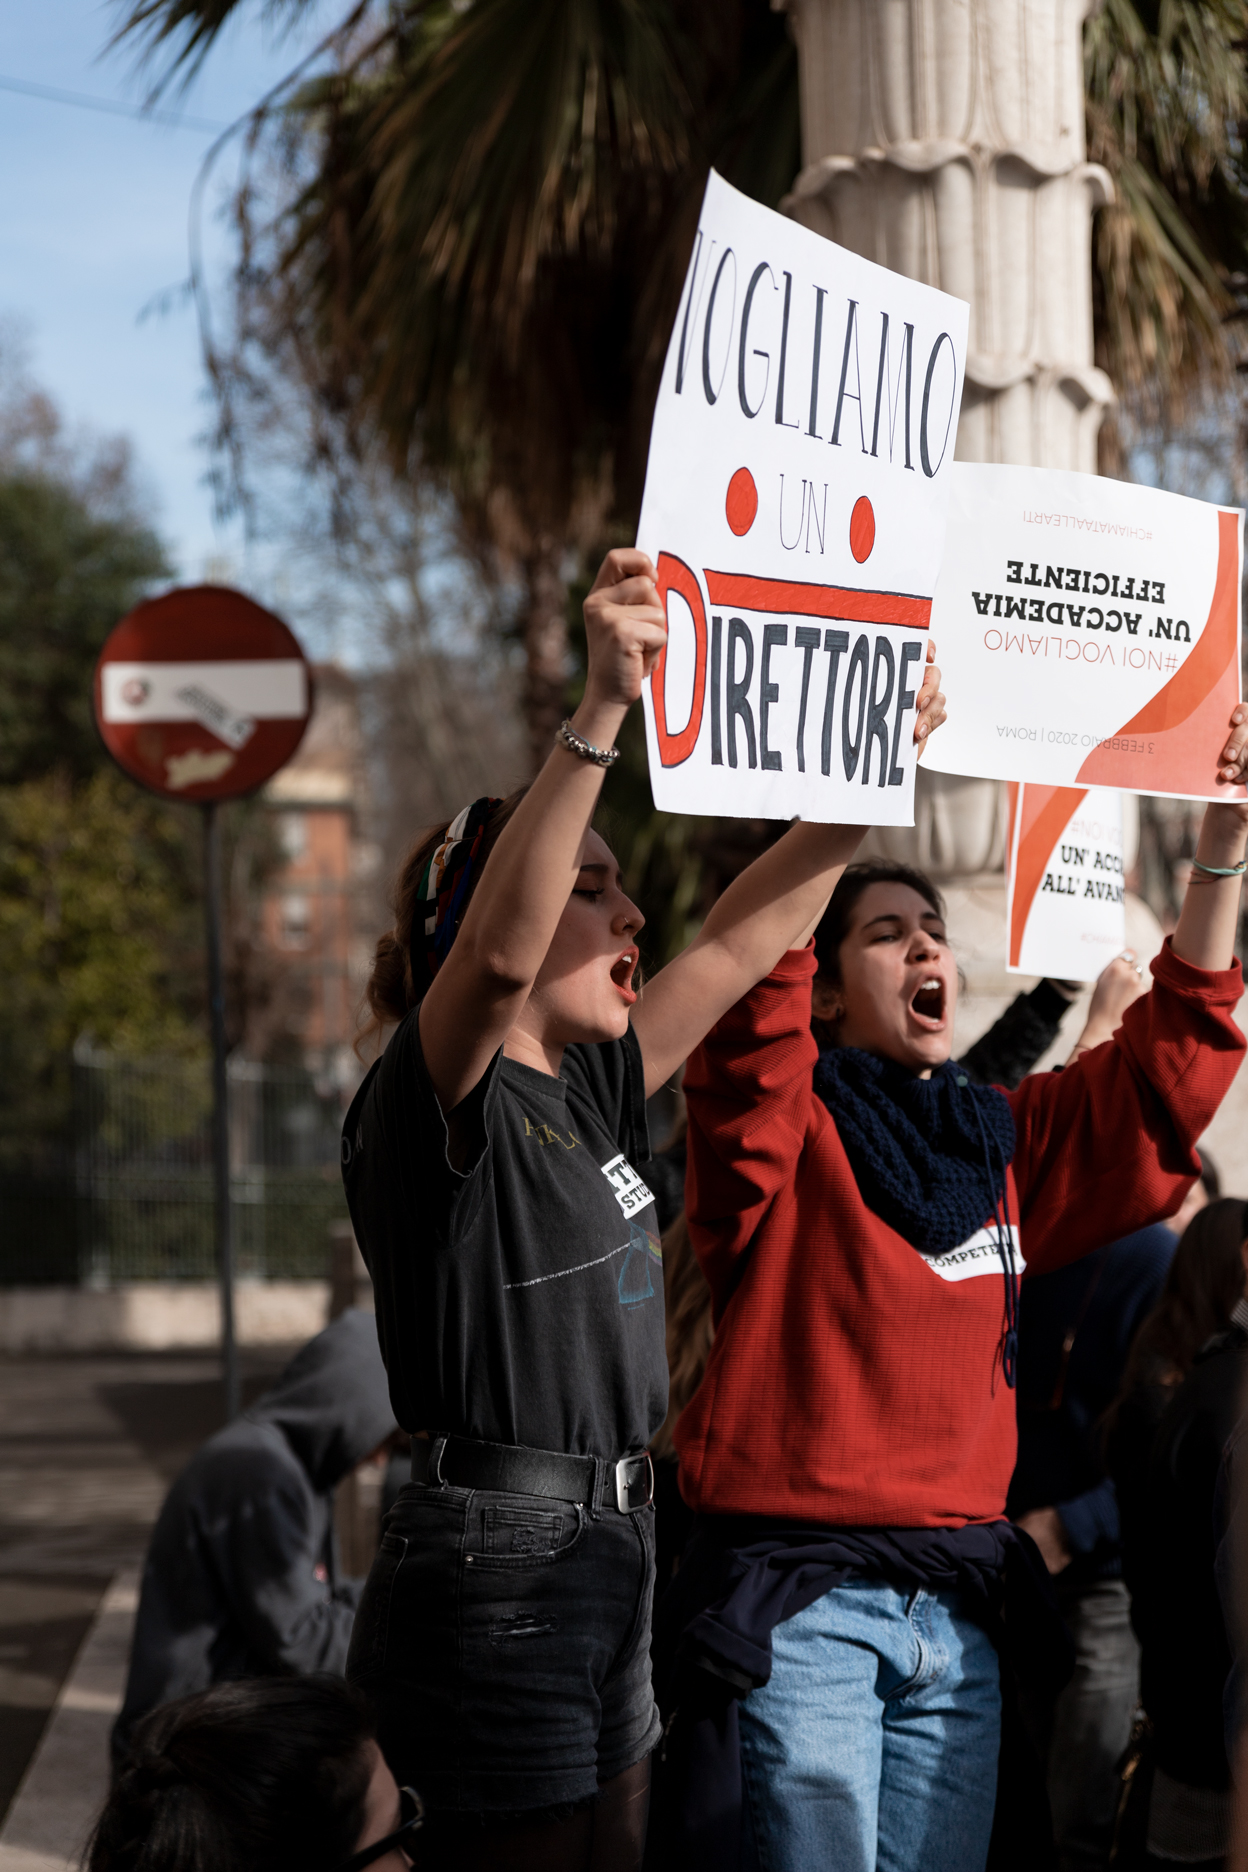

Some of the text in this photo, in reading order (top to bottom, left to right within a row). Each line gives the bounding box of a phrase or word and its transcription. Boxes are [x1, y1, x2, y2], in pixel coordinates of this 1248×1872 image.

[674, 229, 957, 479] VOGLIAMO
[779, 473, 829, 555] UN
[1022, 510, 1153, 541] #CHIAMATAALLEARTI
[1006, 560, 1166, 604] EFFICIENTE
[971, 591, 1192, 643] UN' ACCADEMIA
[984, 629, 1179, 674] #NOI VOGLIAMO
[650, 550, 923, 788] DIRETTORE
[996, 725, 1038, 742] ROMA
[1047, 731, 1078, 746] 2020
[1081, 734, 1145, 754] FEBBRAIO
[1147, 742, 1155, 755] 3
[1061, 844, 1090, 866] UN'
[1042, 873, 1080, 896] ALL'
